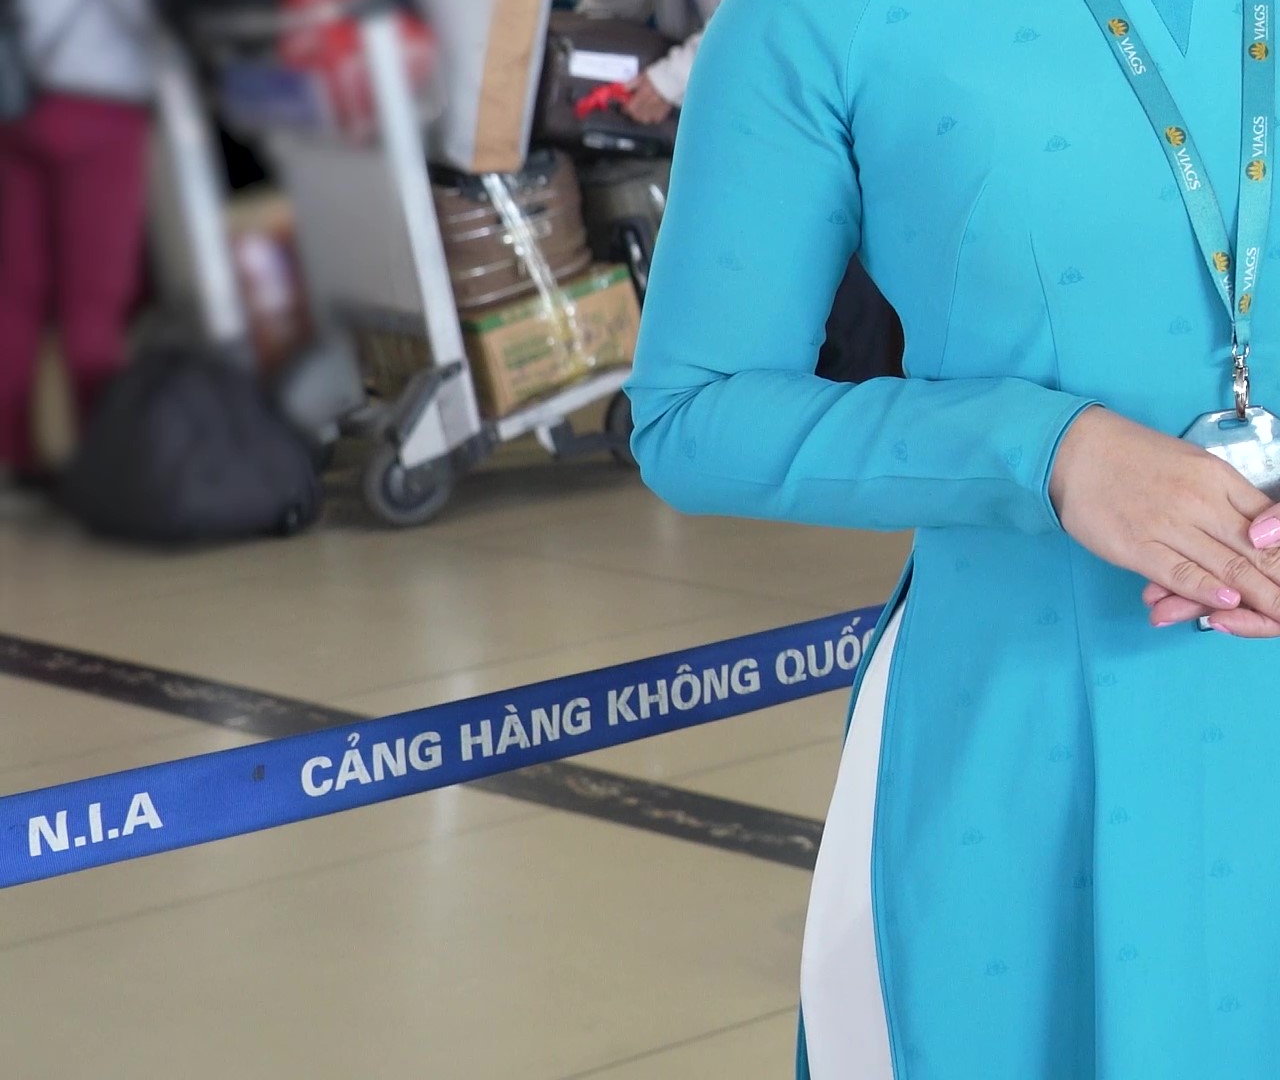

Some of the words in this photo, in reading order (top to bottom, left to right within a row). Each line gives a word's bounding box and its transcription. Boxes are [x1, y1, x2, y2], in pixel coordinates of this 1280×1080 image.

[1254, 4, 1266, 41] VIAGS
[1120, 37, 1146, 75] VIAGS
[1252, 116, 1265, 158] VIAGS
[1177, 147, 1201, 190] VIAGS
[1243, 247, 1257, 291] VIAGS
[27, 792, 164, 858] N.I.A
[300, 731, 443, 798] CẢNG
[460, 696, 592, 762] HÀNG
[606, 664, 762, 726] KHÔNG
